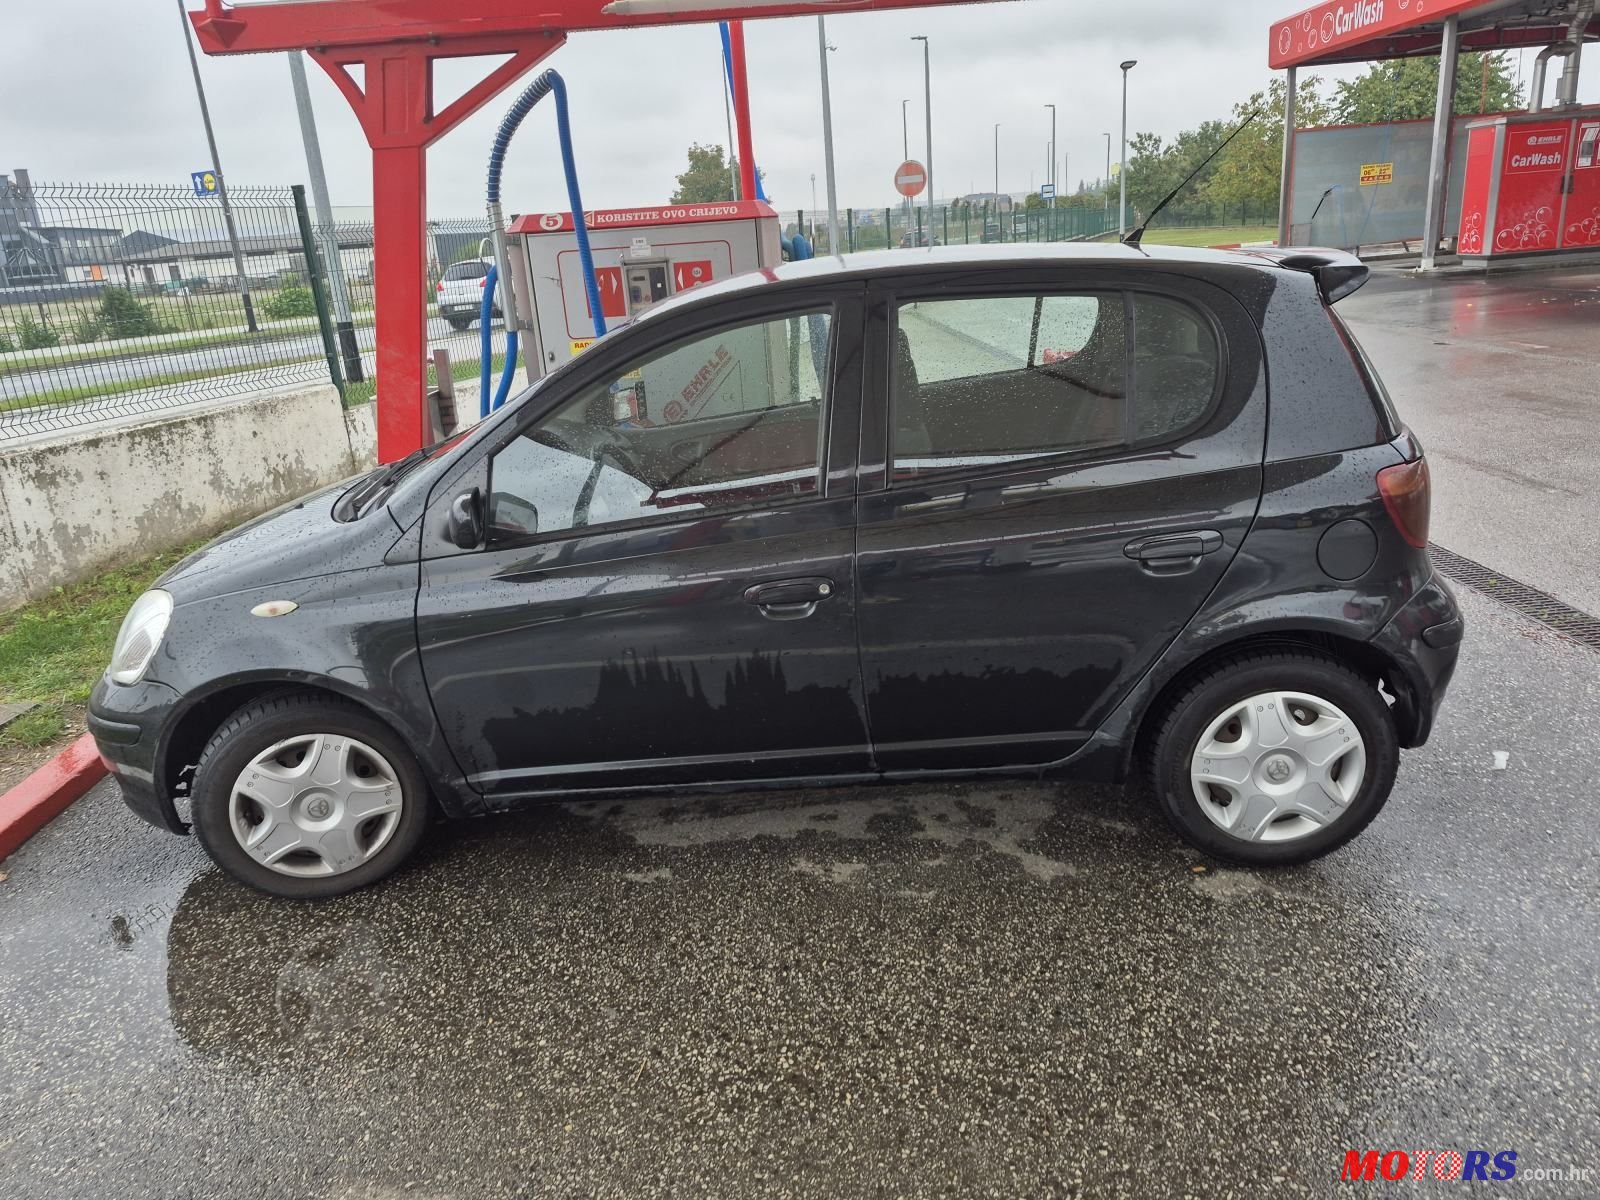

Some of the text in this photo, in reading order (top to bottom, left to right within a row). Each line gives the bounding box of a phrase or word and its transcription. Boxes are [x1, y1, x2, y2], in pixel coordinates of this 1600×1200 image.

[1335, 0, 1384, 35] CarWash
[1511, 151, 1561, 168] CarWash
[545, 206, 738, 227] 5 KORISTITE OVO CRIJEVO
